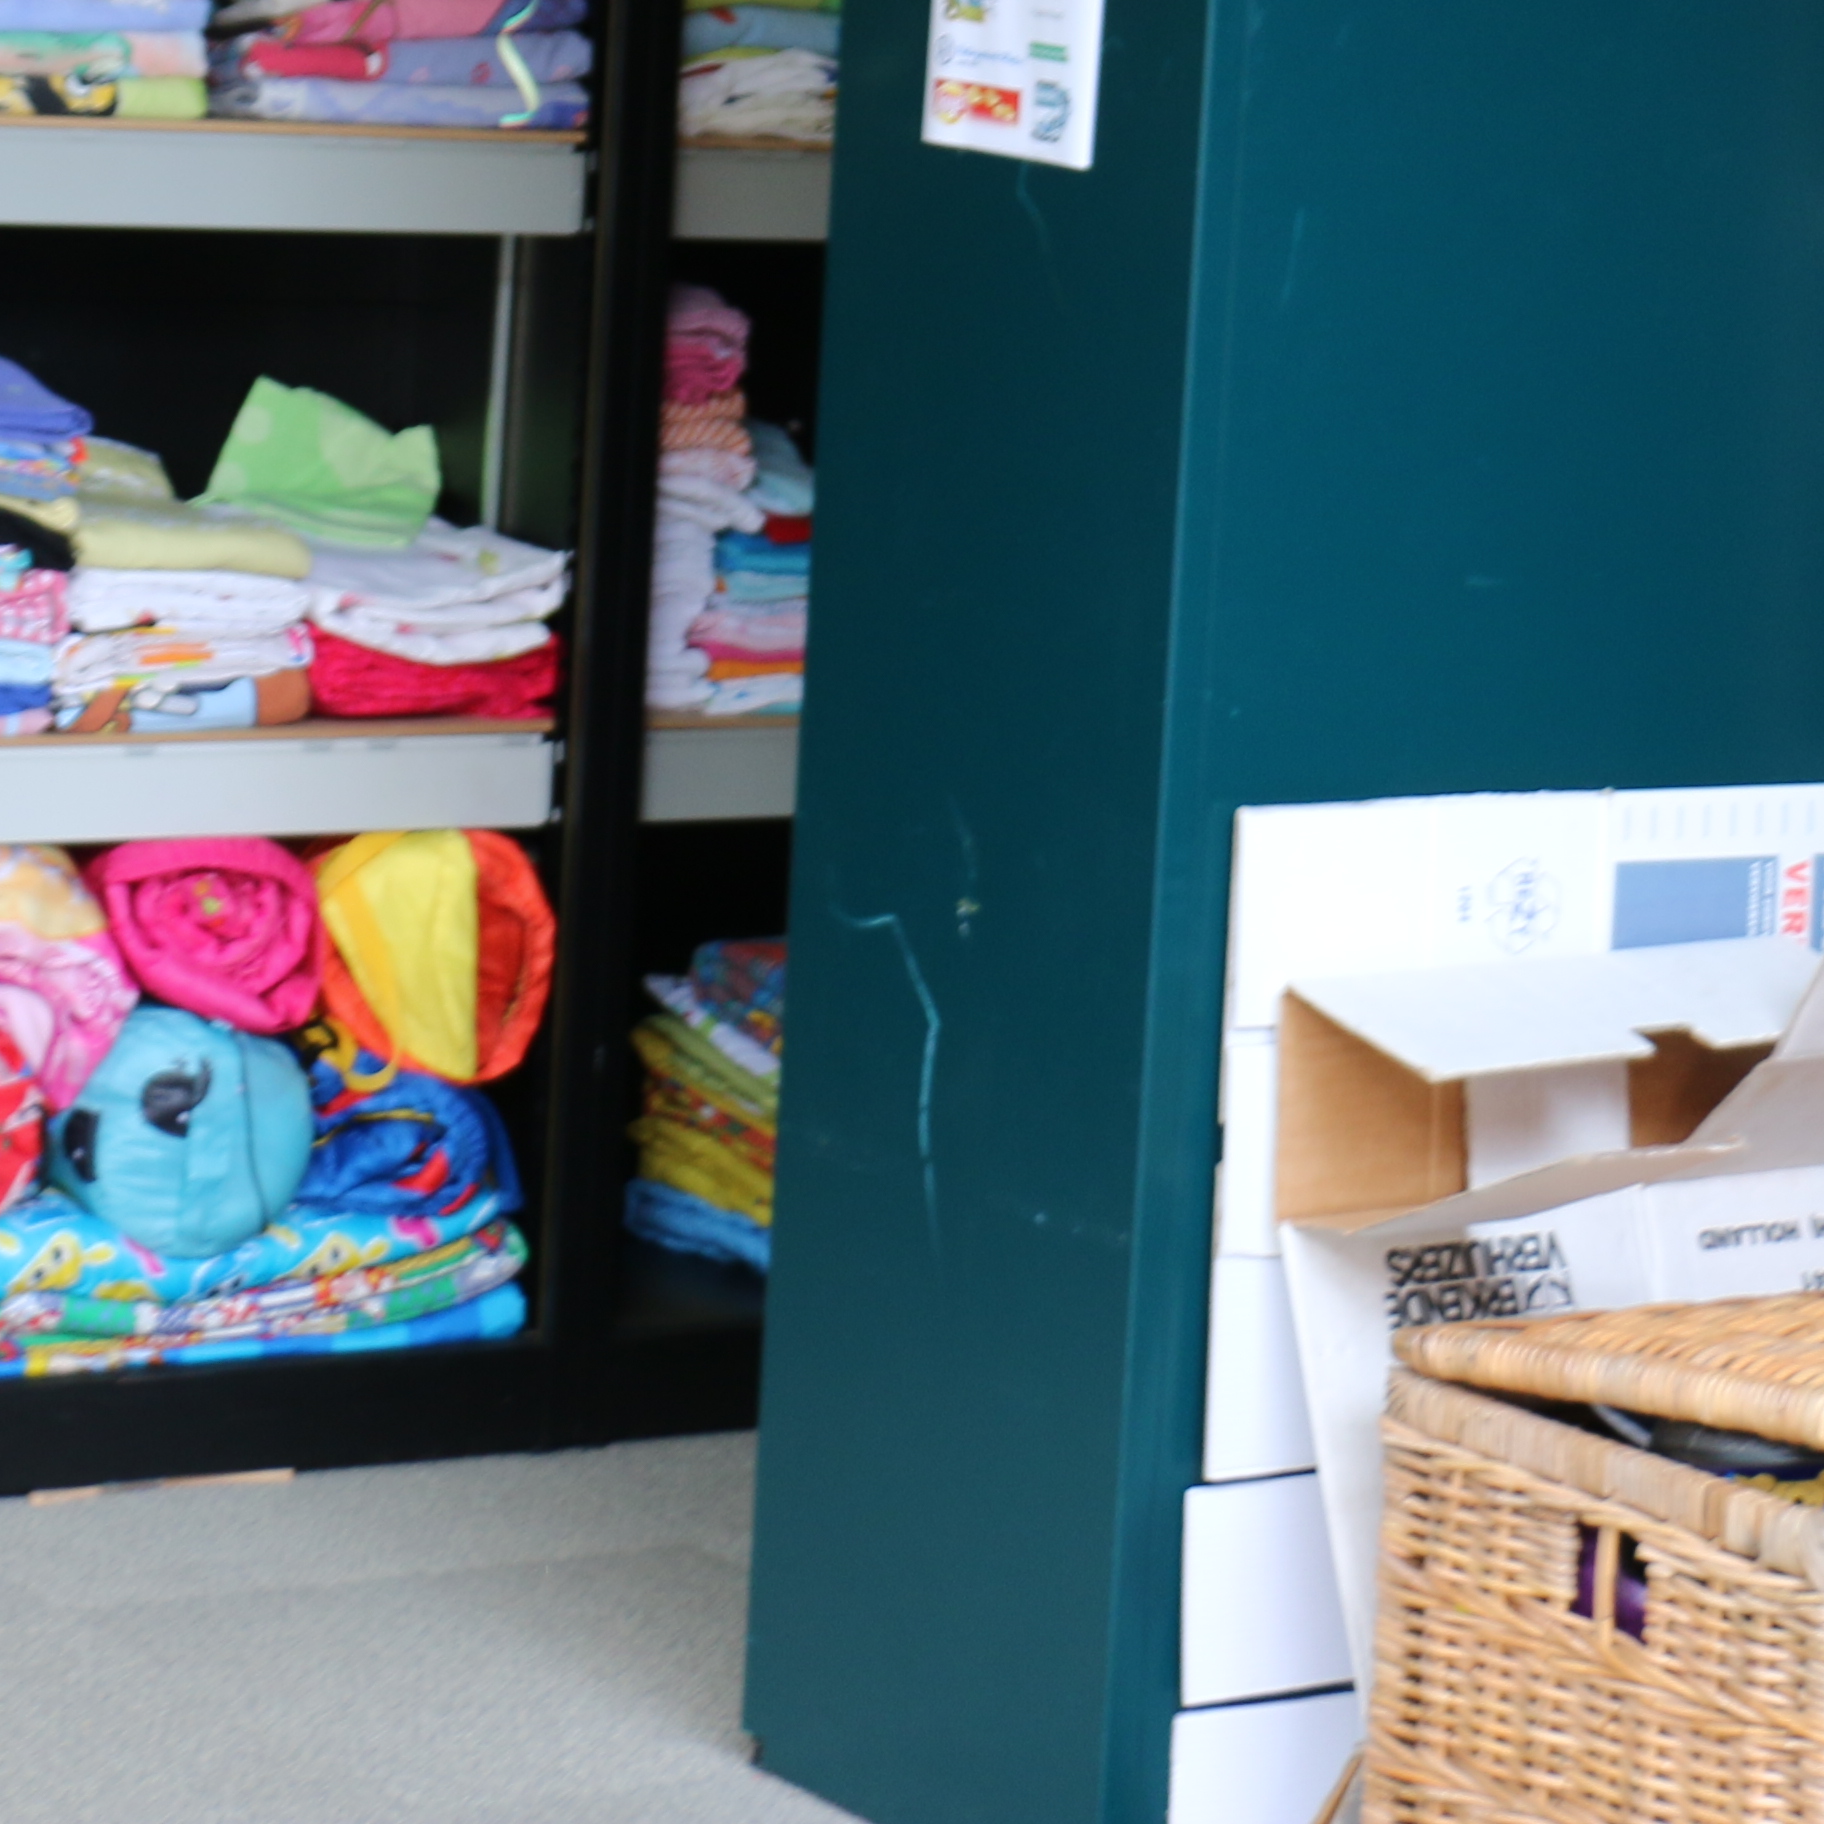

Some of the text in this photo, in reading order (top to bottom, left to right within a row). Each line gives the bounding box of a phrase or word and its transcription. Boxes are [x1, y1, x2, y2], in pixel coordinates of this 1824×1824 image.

[1780, 857, 1811, 946] VER
[1385, 1229, 1567, 1286] VERHUIZERS
[1697, 1219, 1802, 1250] HOLLAND
[1384, 1277, 1519, 1329] ERKENDE
